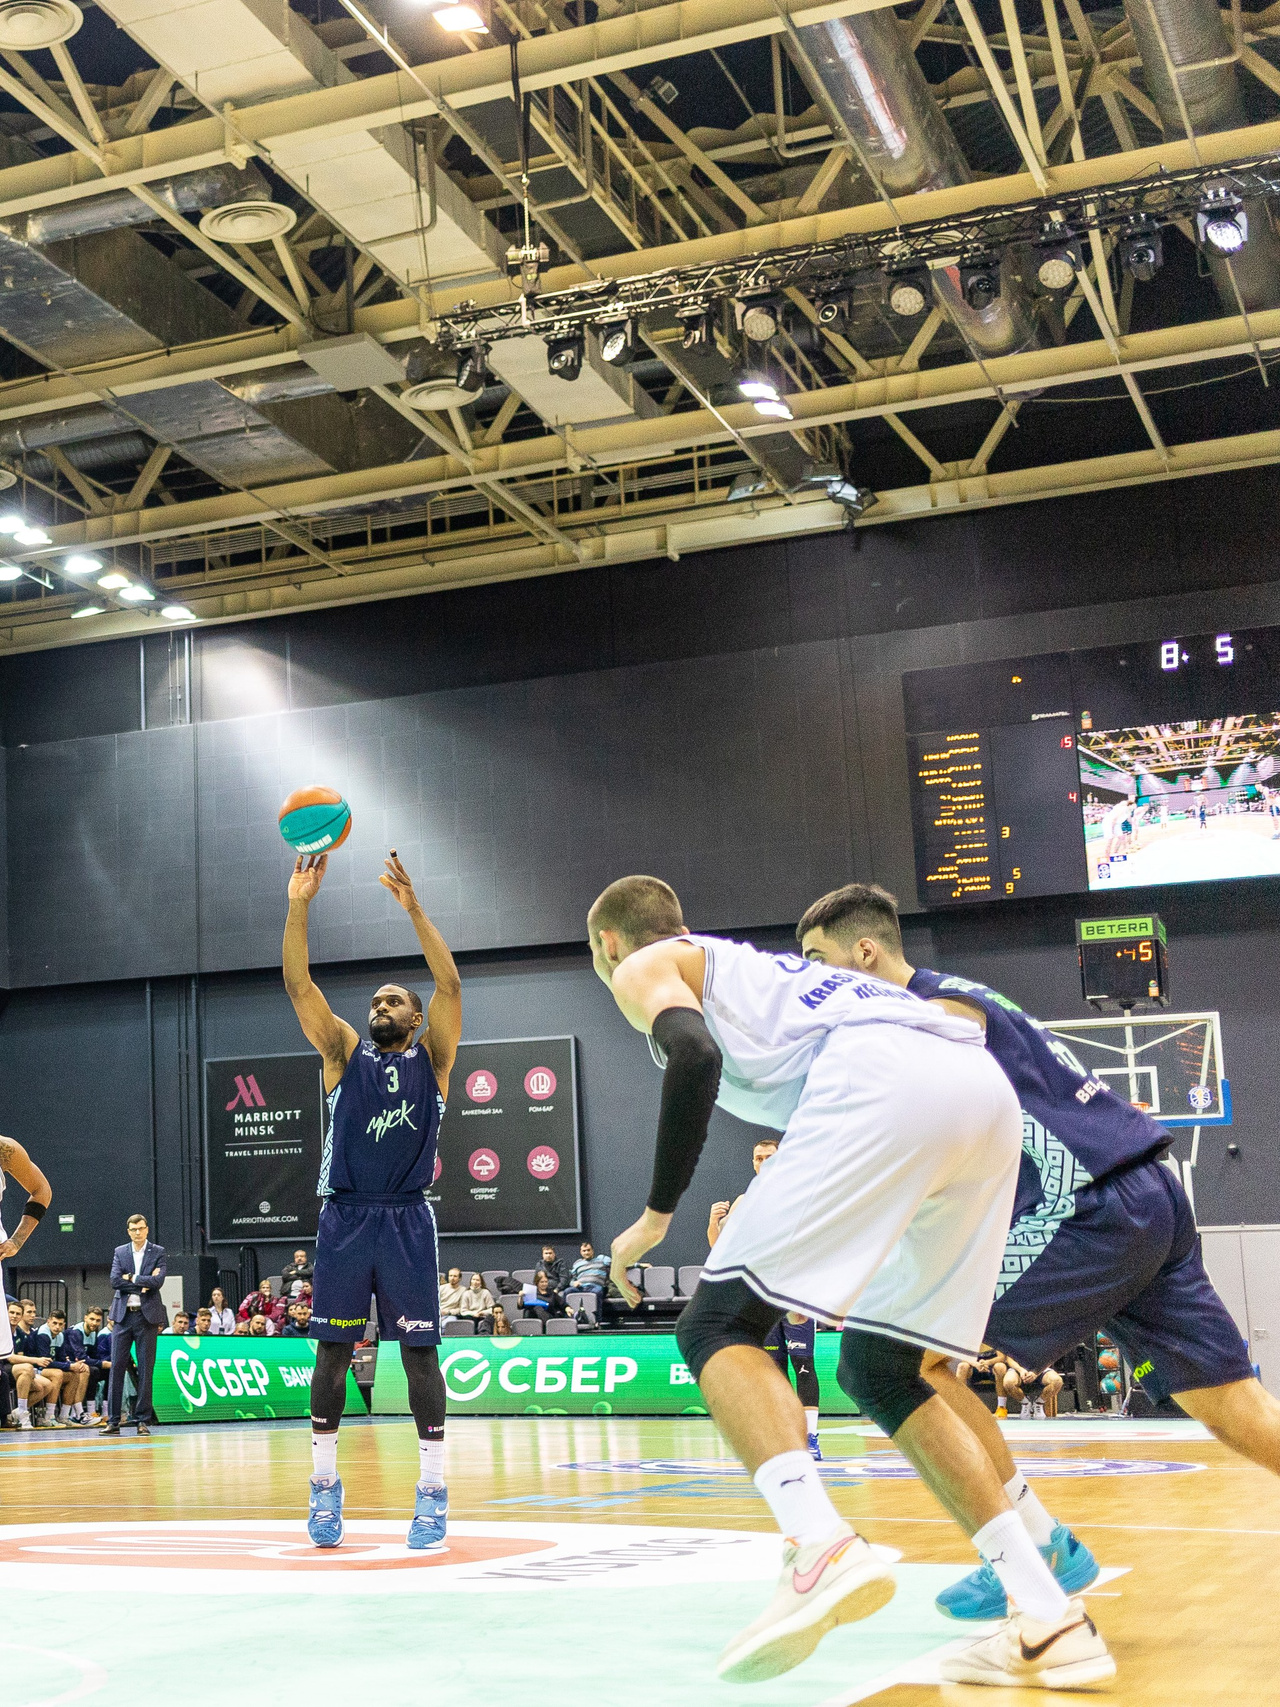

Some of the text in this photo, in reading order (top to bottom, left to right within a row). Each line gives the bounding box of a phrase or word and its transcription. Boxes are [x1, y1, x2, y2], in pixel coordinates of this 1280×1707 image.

[1068, 792, 1078, 803] 4
[1001, 826, 1010, 838] 3
[1012, 868, 1021, 879] 5
[1005, 882, 1014, 894] 9
[385, 1066, 399, 1093] 3
[234, 1110, 302, 1123] MARRIOTT
[234, 1125, 275, 1137] MINSK
[253, 1148, 303, 1156] BRILLIANTLY
[232, 1215, 298, 1225] MARRIOTTMINSK.COM
[202, 1358, 270, 1397] СБЕР
[498, 1356, 638, 1393] СБЕР
